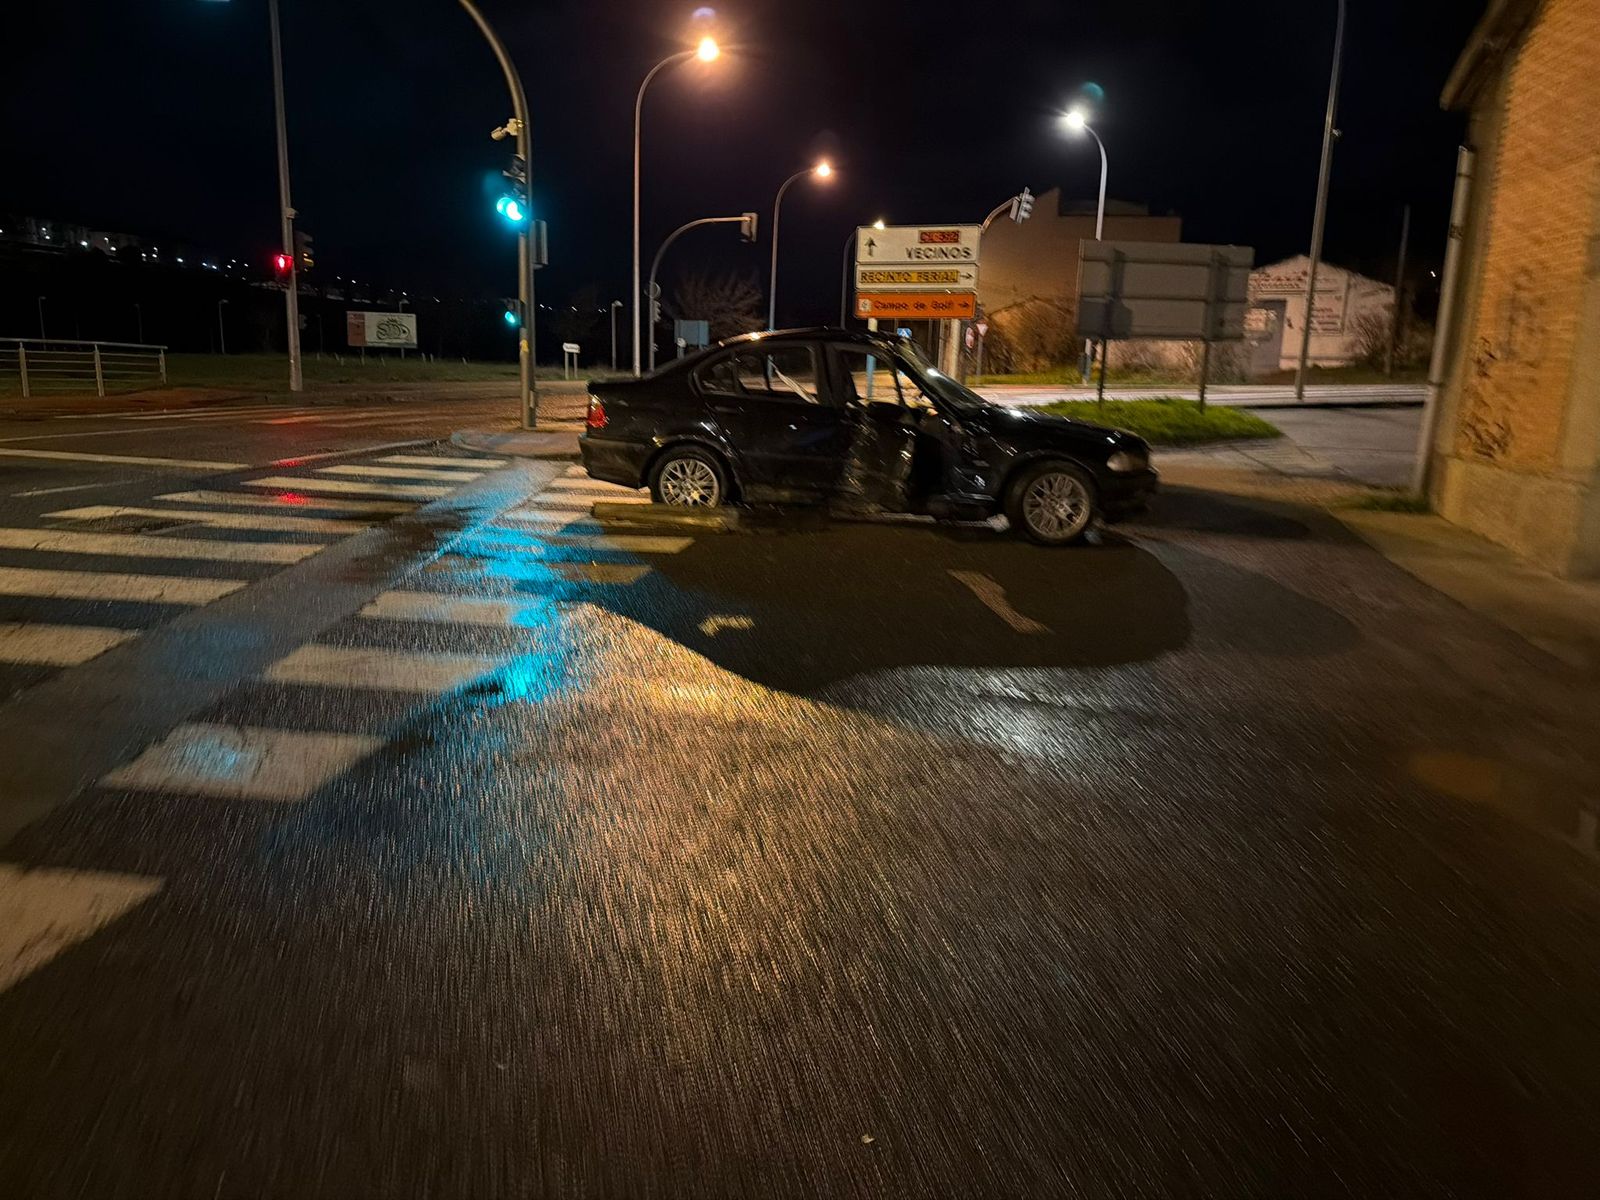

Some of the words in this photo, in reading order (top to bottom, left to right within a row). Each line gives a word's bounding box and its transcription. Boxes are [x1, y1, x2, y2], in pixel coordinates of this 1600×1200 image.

[905, 247, 972, 259] VECINOS
[860, 271, 912, 282] RECINTO
[916, 271, 958, 282] FERIAL
[874, 301, 909, 311] Campo
[913, 301, 926, 310] de
[931, 301, 954, 310] Golf
